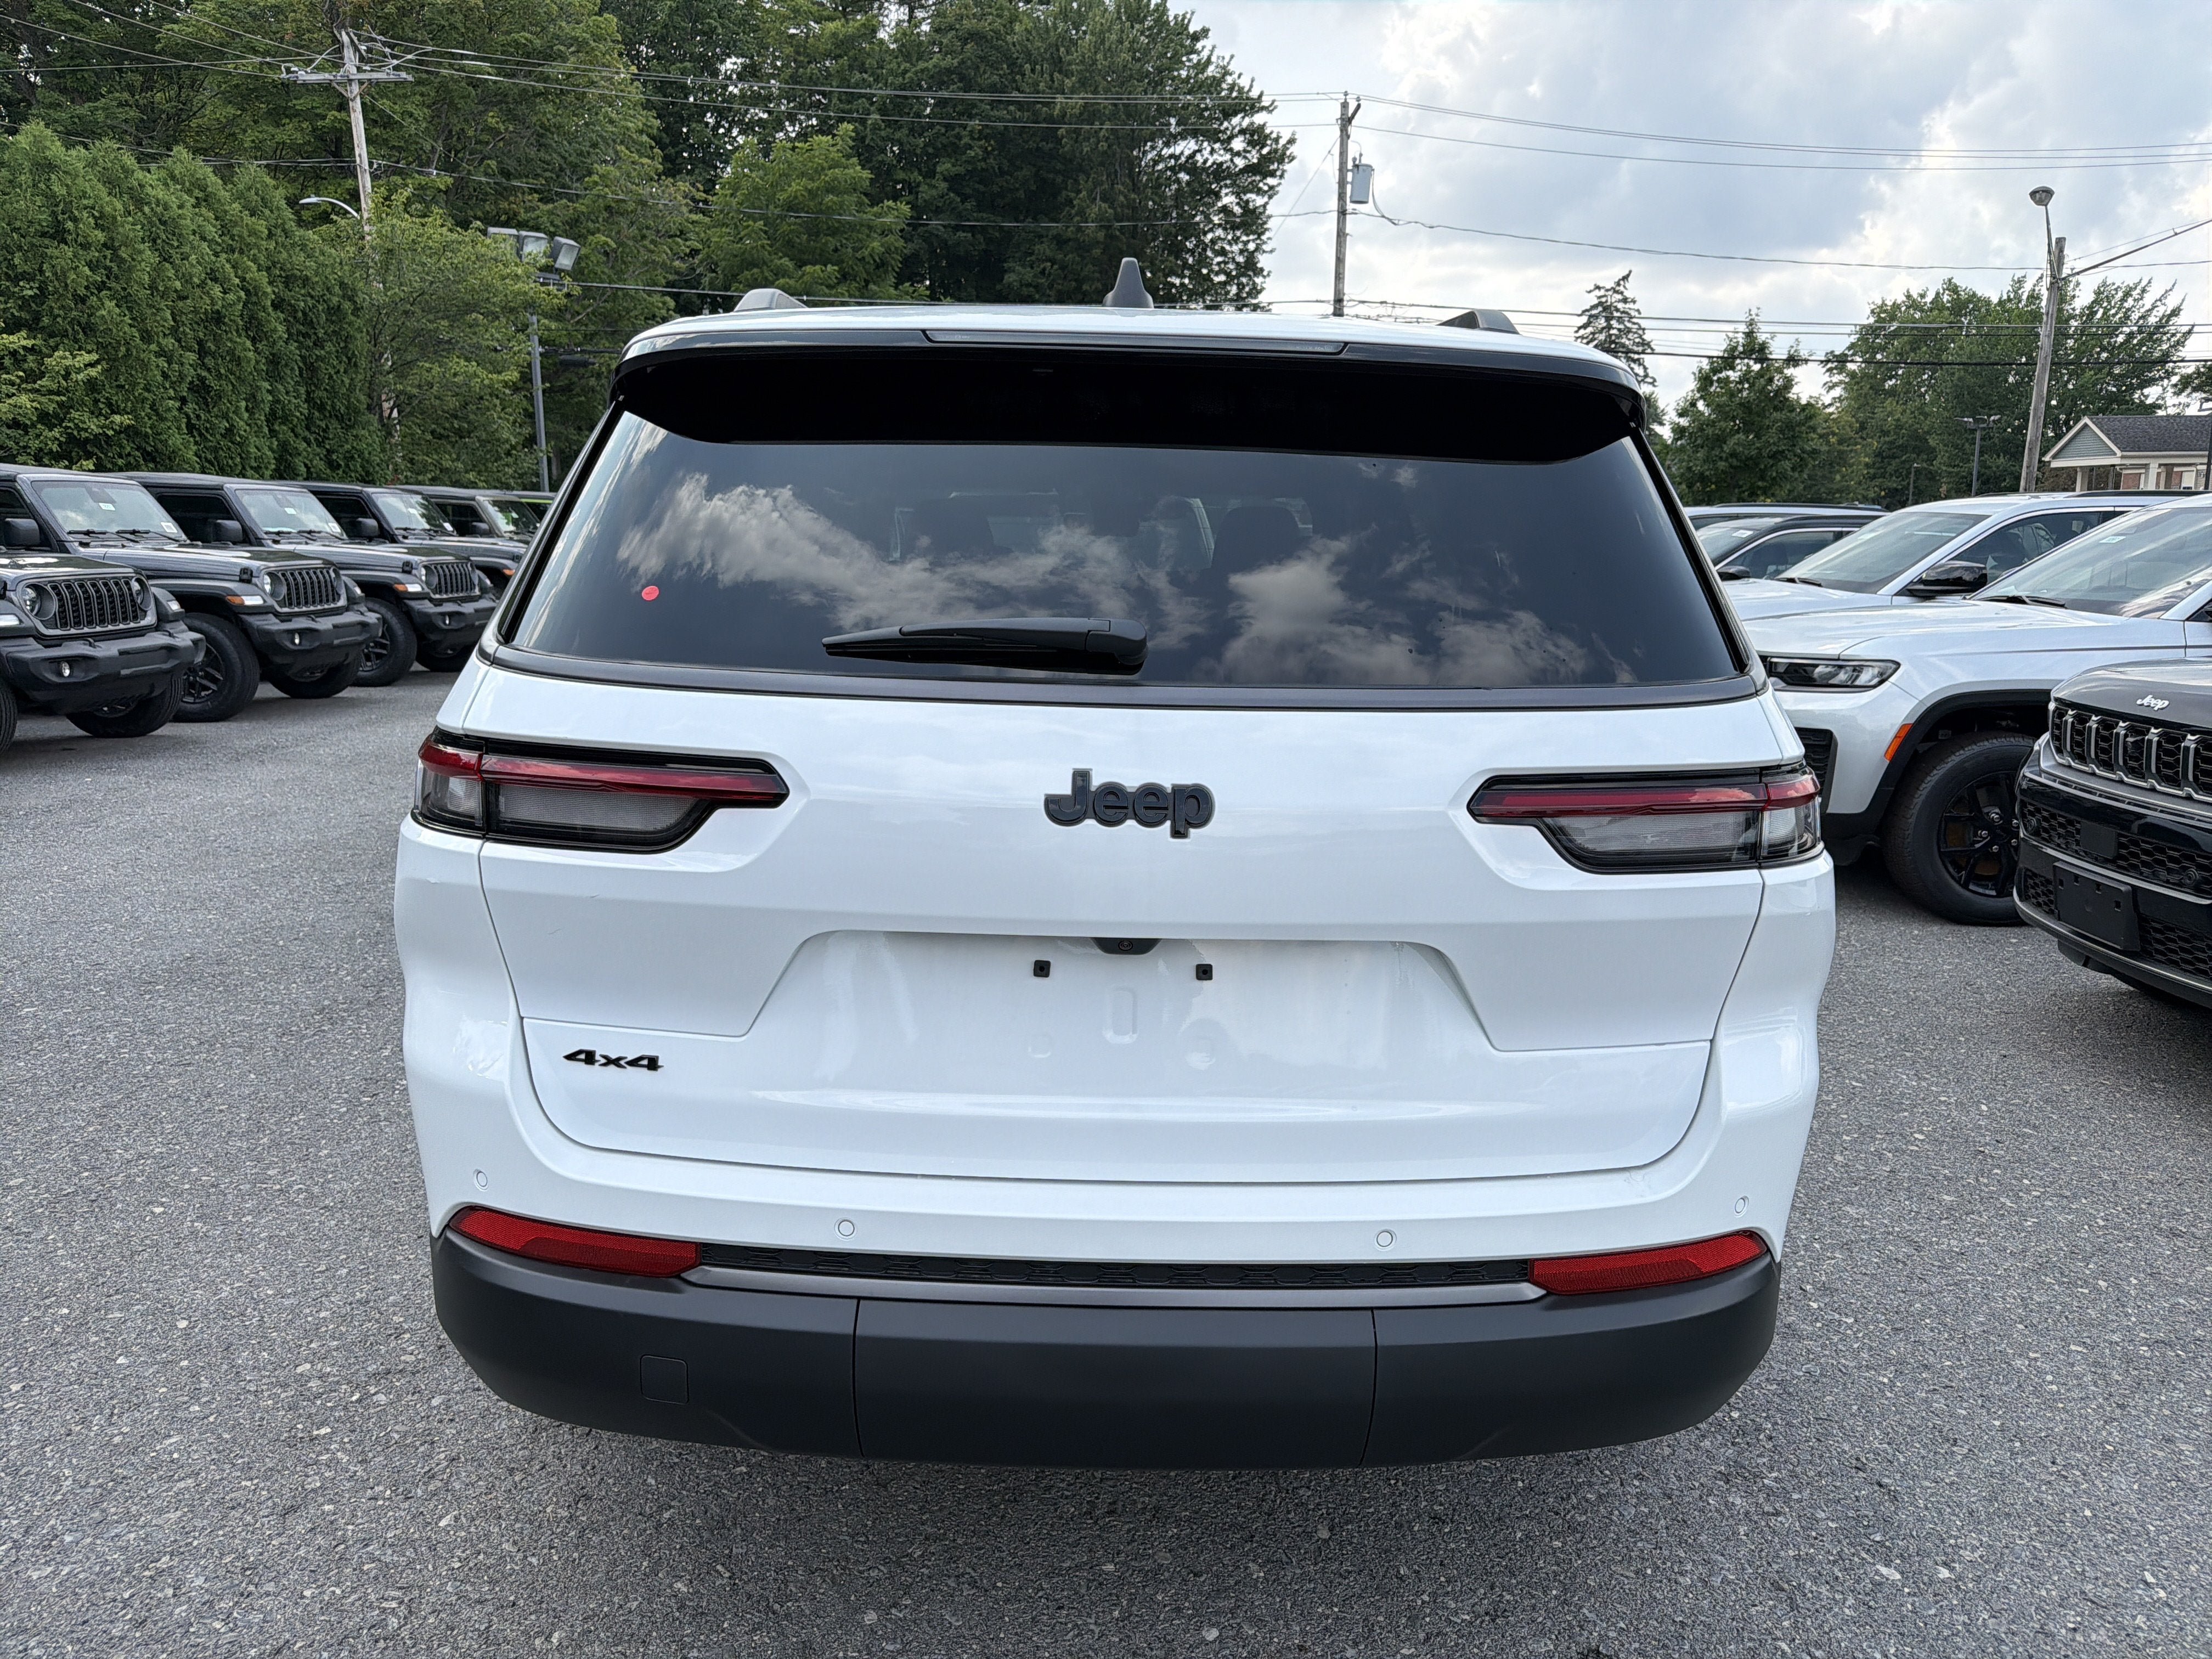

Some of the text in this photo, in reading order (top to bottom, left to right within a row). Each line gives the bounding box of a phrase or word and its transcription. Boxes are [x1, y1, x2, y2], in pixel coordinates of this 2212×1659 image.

[2136, 695, 2170, 711] Jeep
[1045, 769, 1215, 838] Jeep
[562, 1048, 664, 1071] 4x4
